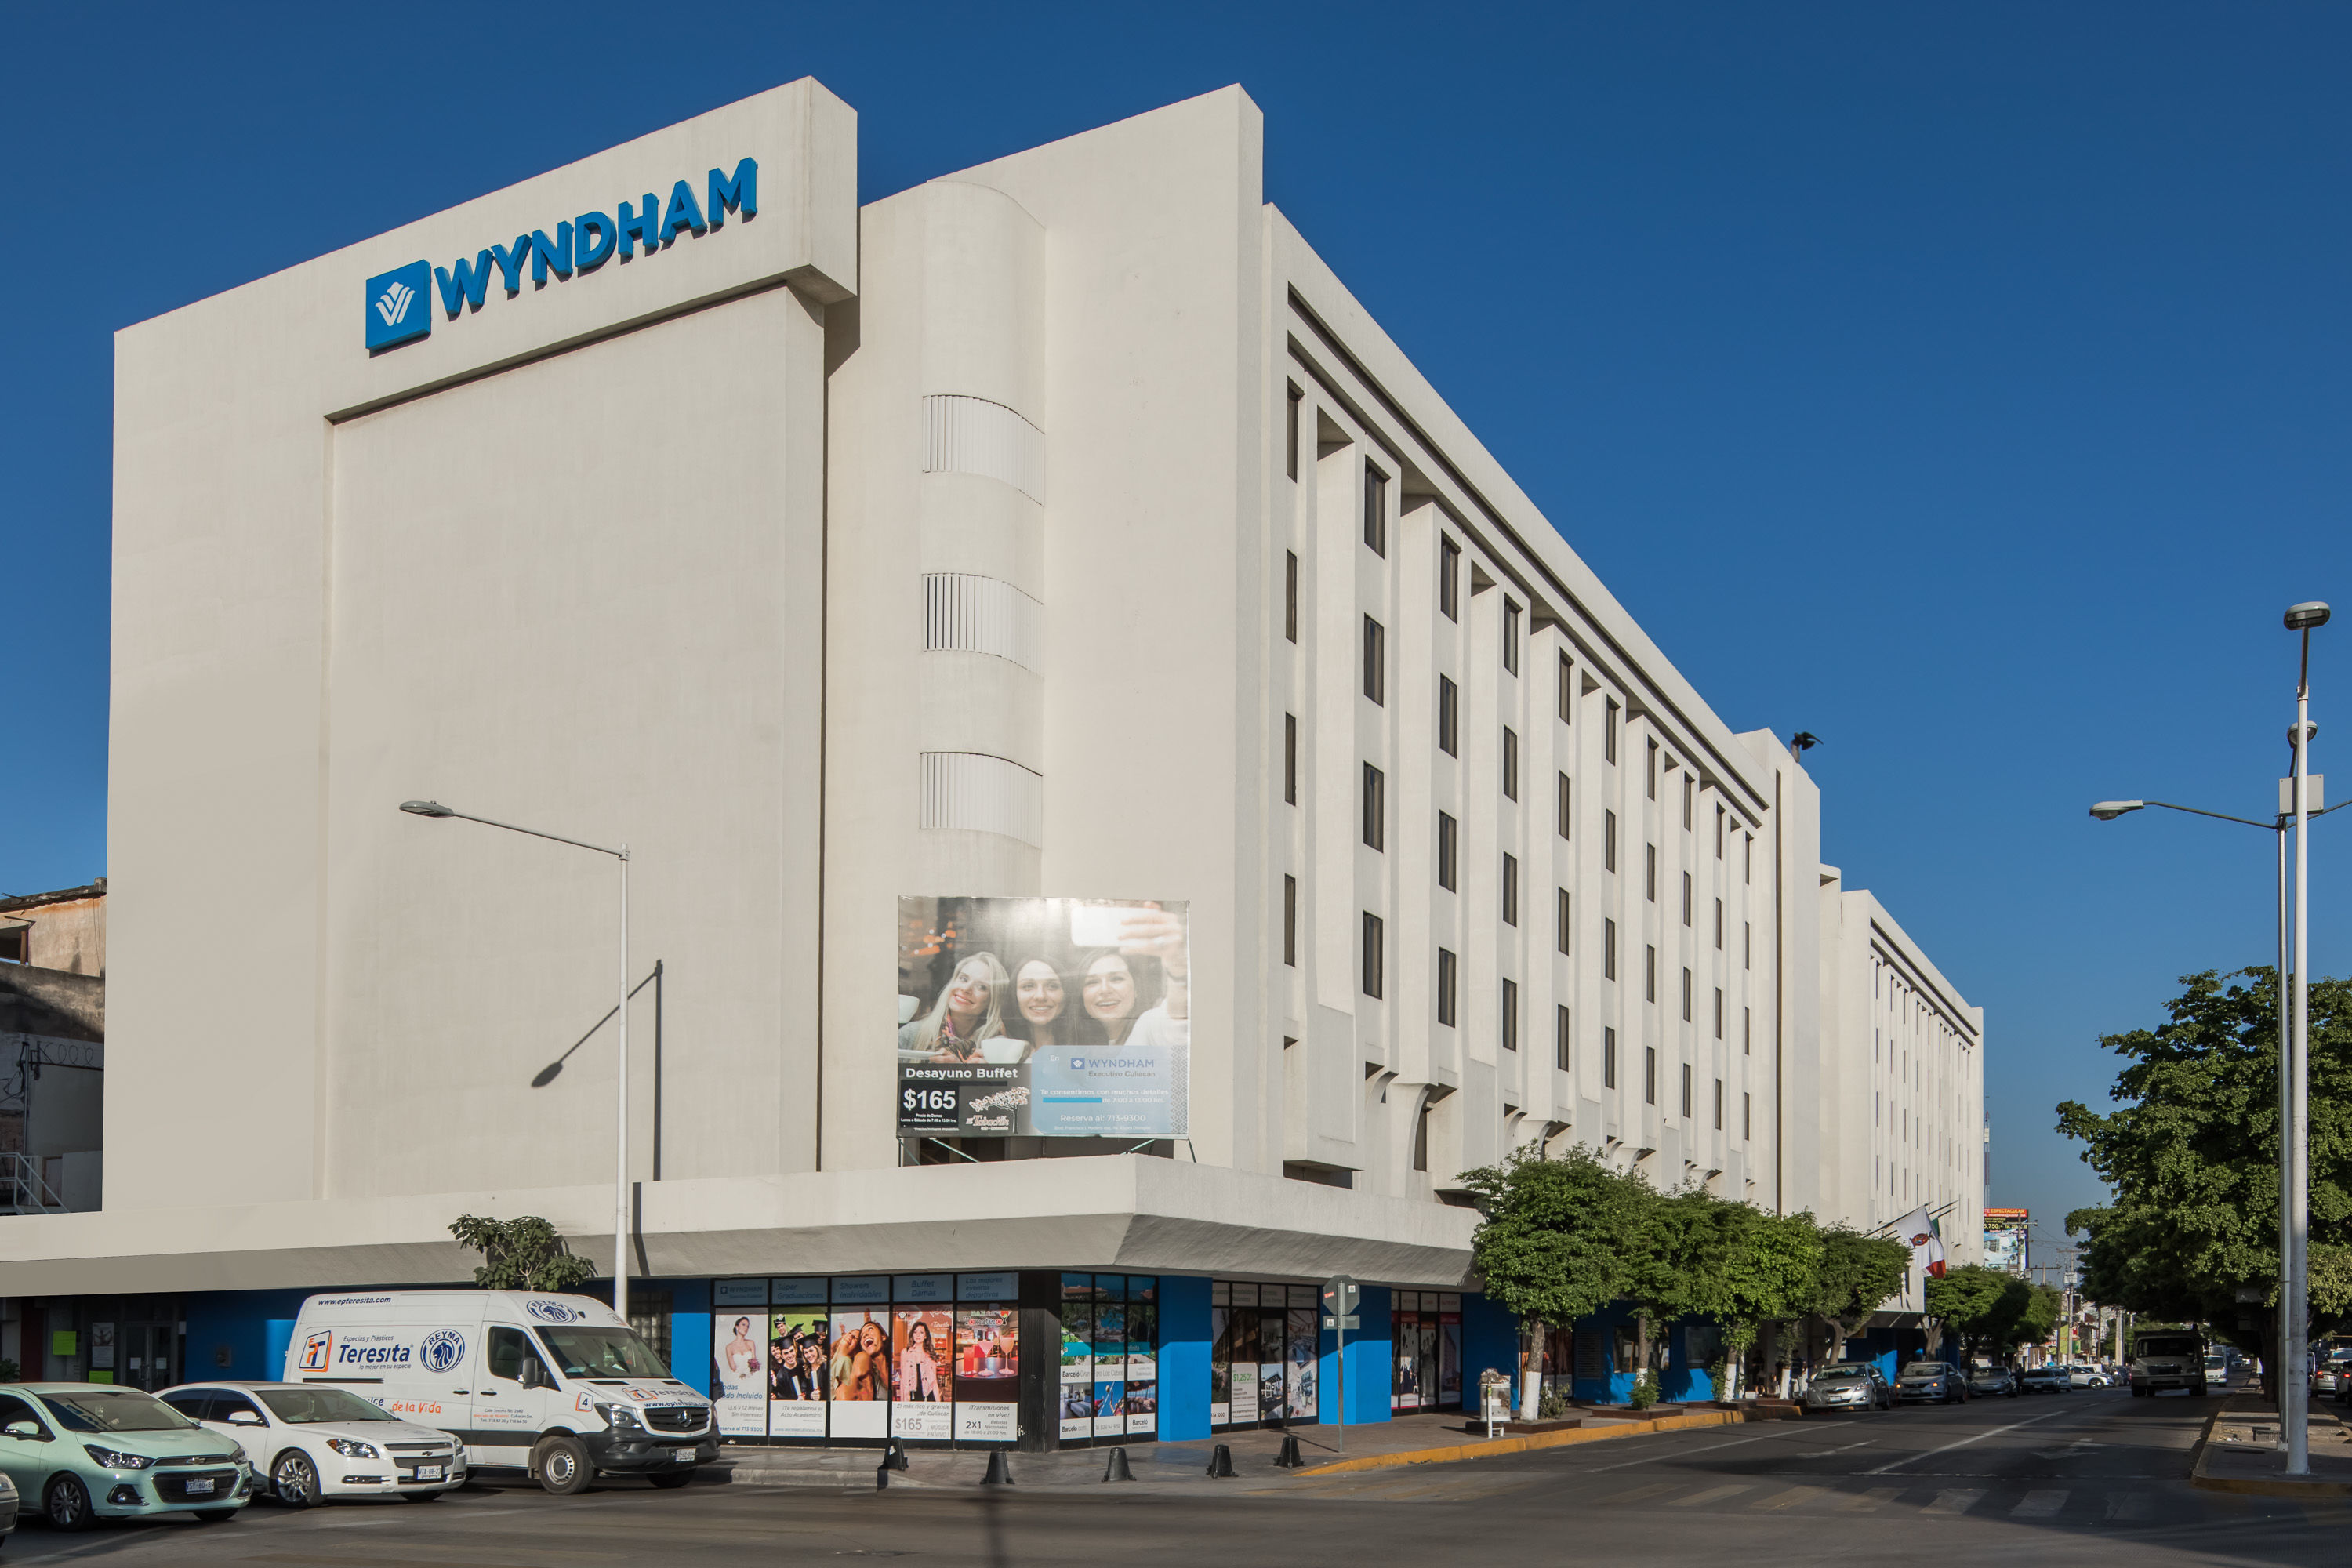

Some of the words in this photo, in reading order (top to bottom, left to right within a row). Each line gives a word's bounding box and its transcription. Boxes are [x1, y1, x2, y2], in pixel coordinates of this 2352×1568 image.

[434, 157, 758, 317] WYNDHAM
[1088, 1059, 1154, 1068] WYNDHAM
[906, 1068, 972, 1080] Desayuno
[976, 1068, 1018, 1078] Buffet
[903, 1088, 956, 1110] $165
[318, 1297, 391, 1305] www.epteresita.com
[428, 1330, 460, 1345] REYMA
[339, 1344, 410, 1363] Teresita
[392, 1401, 403, 1411] de
[405, 1401, 415, 1411] la
[419, 1401, 441, 1413] Vida
[582, 1398, 588, 1407] 4
[895, 1417, 922, 1430] $165
